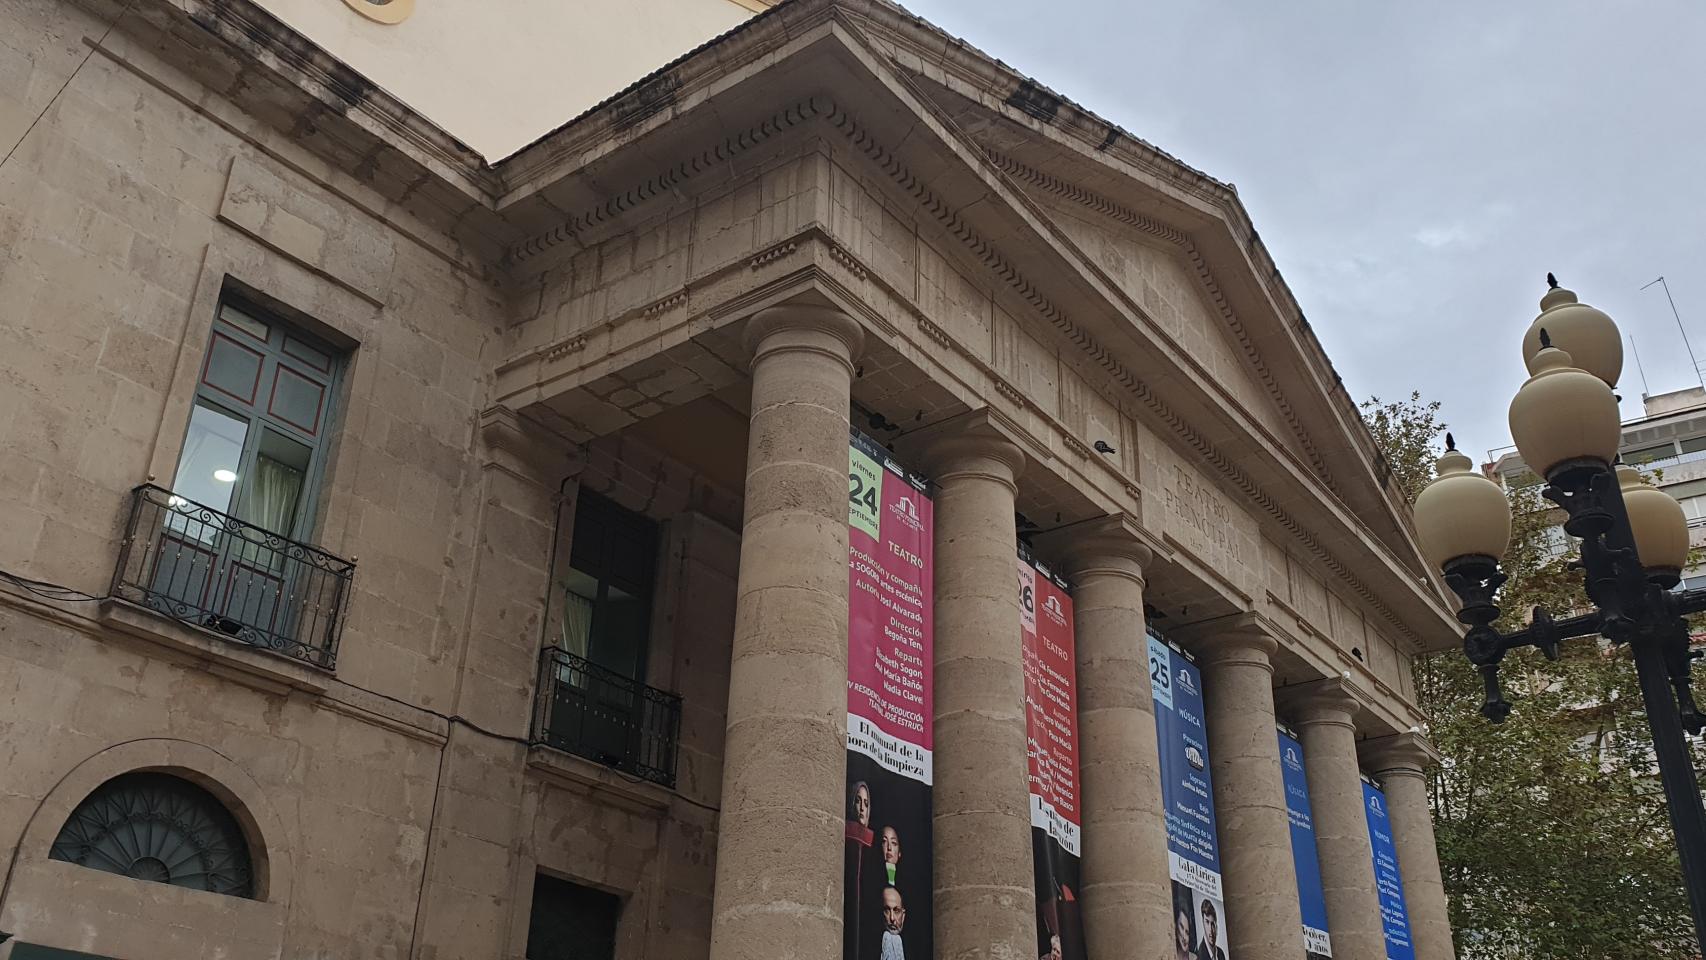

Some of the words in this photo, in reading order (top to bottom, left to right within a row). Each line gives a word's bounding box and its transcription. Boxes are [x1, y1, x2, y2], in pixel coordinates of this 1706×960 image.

[851, 460, 876, 480] viernes
[849, 473, 877, 516] 24
[1174, 464, 1230, 523] TEATRO
[1165, 487, 1243, 565] PRINCIPAL
[850, 546, 885, 575] Producción
[885, 570, 891, 580] y
[888, 540, 923, 569] TEATRO
[884, 625, 908, 645] Begoña
[1043, 636, 1068, 661] TEATRO
[1150, 657, 1170, 689] 25
[1178, 706, 1201, 728] MÚSICA
[860, 721, 869, 735] El
[871, 730, 898, 753] manual
[900, 745, 912, 759] de
[916, 749, 924, 762] la
[869, 743, 878, 755] de
[884, 752, 924, 776] limpieza
[1063, 821, 1074, 837] de
